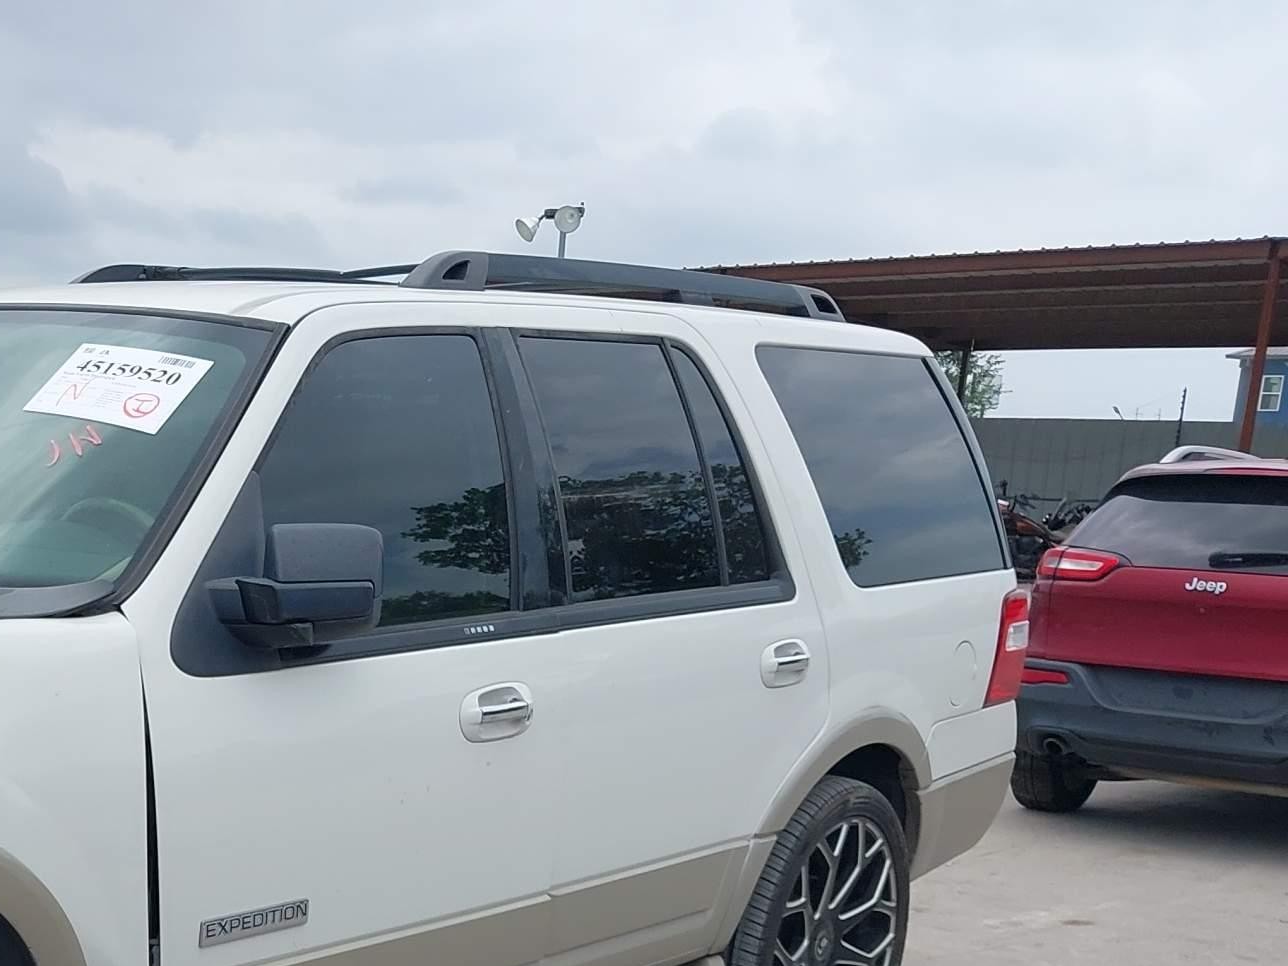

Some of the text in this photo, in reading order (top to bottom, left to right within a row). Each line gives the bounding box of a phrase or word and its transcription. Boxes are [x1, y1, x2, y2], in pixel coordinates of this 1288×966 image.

[76, 359, 182, 386] 45159520
[1185, 577, 1228, 595] Jeep
[205, 902, 308, 938] EXPEDITION
